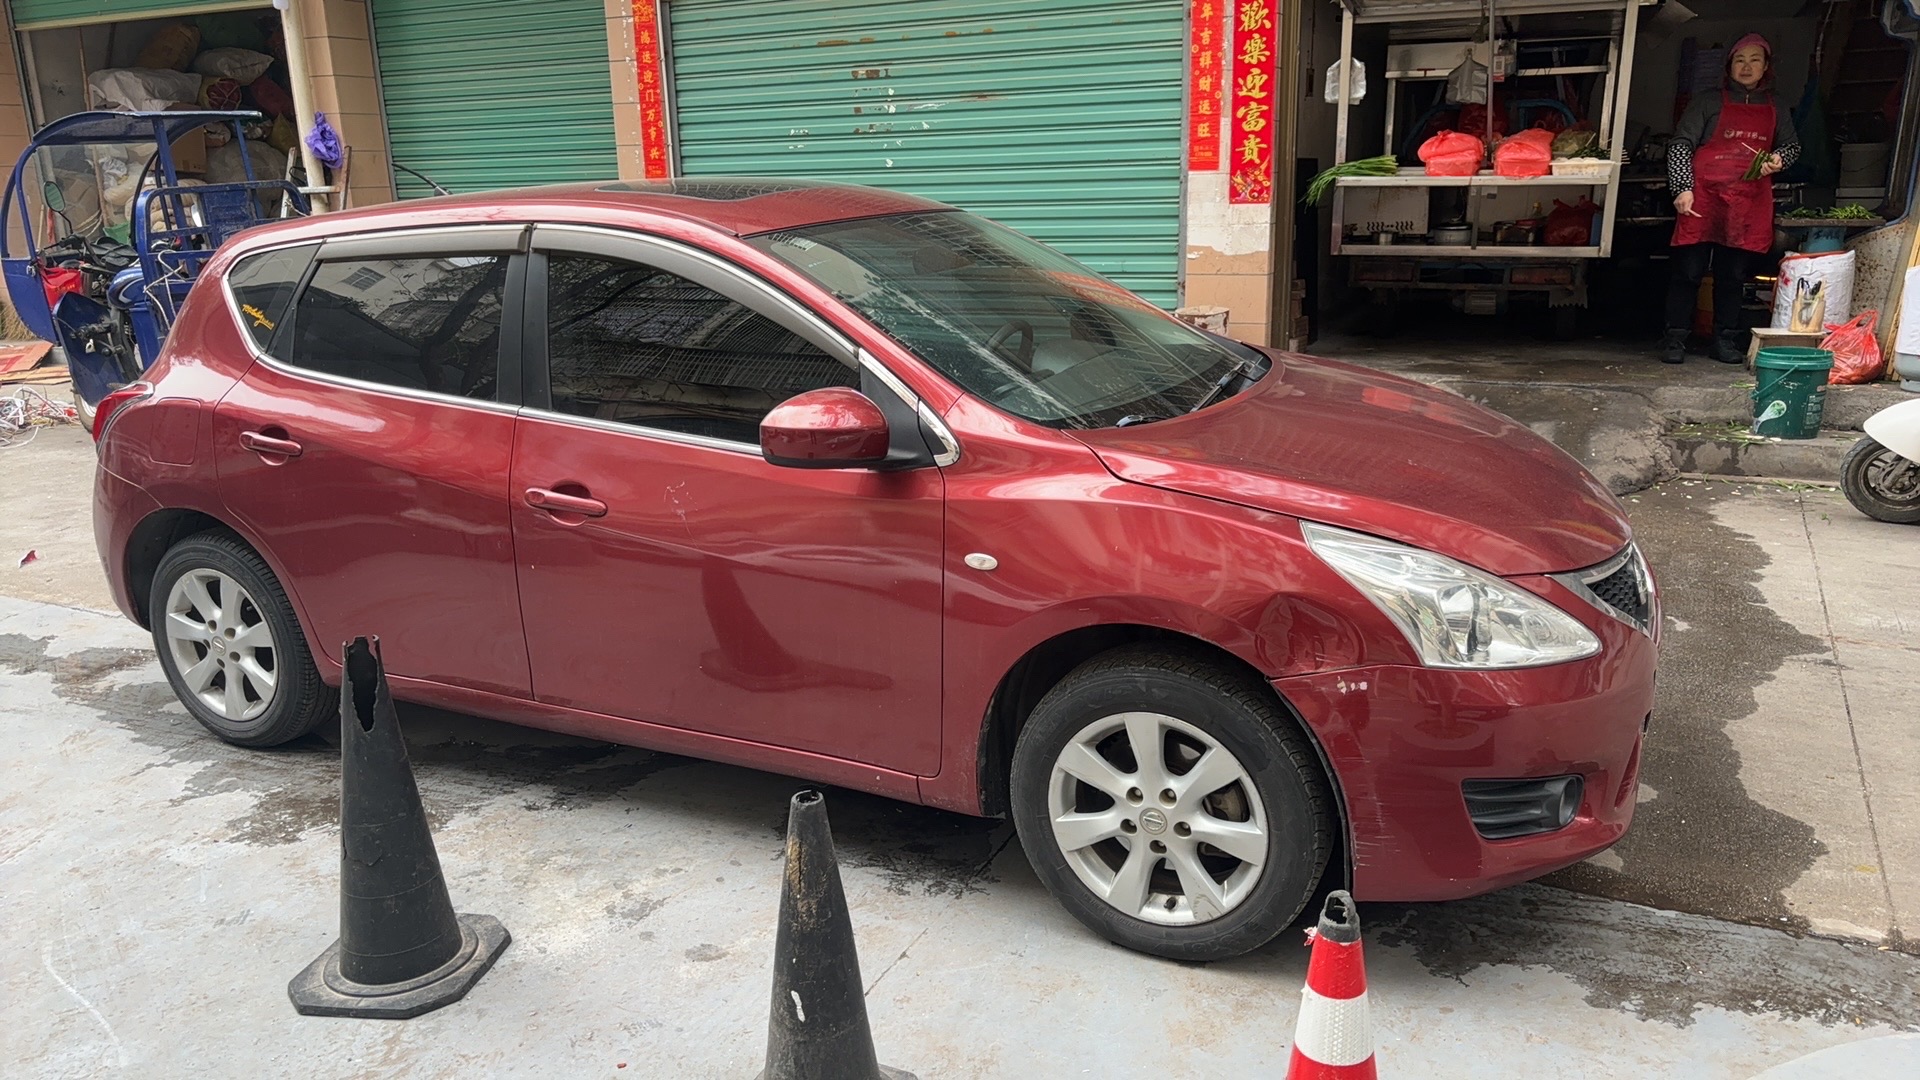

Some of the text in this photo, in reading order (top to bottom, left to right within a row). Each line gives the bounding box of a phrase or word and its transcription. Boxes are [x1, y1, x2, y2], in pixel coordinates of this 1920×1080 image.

[1197, 2, 1214, 138] 年吉祥财运旺
